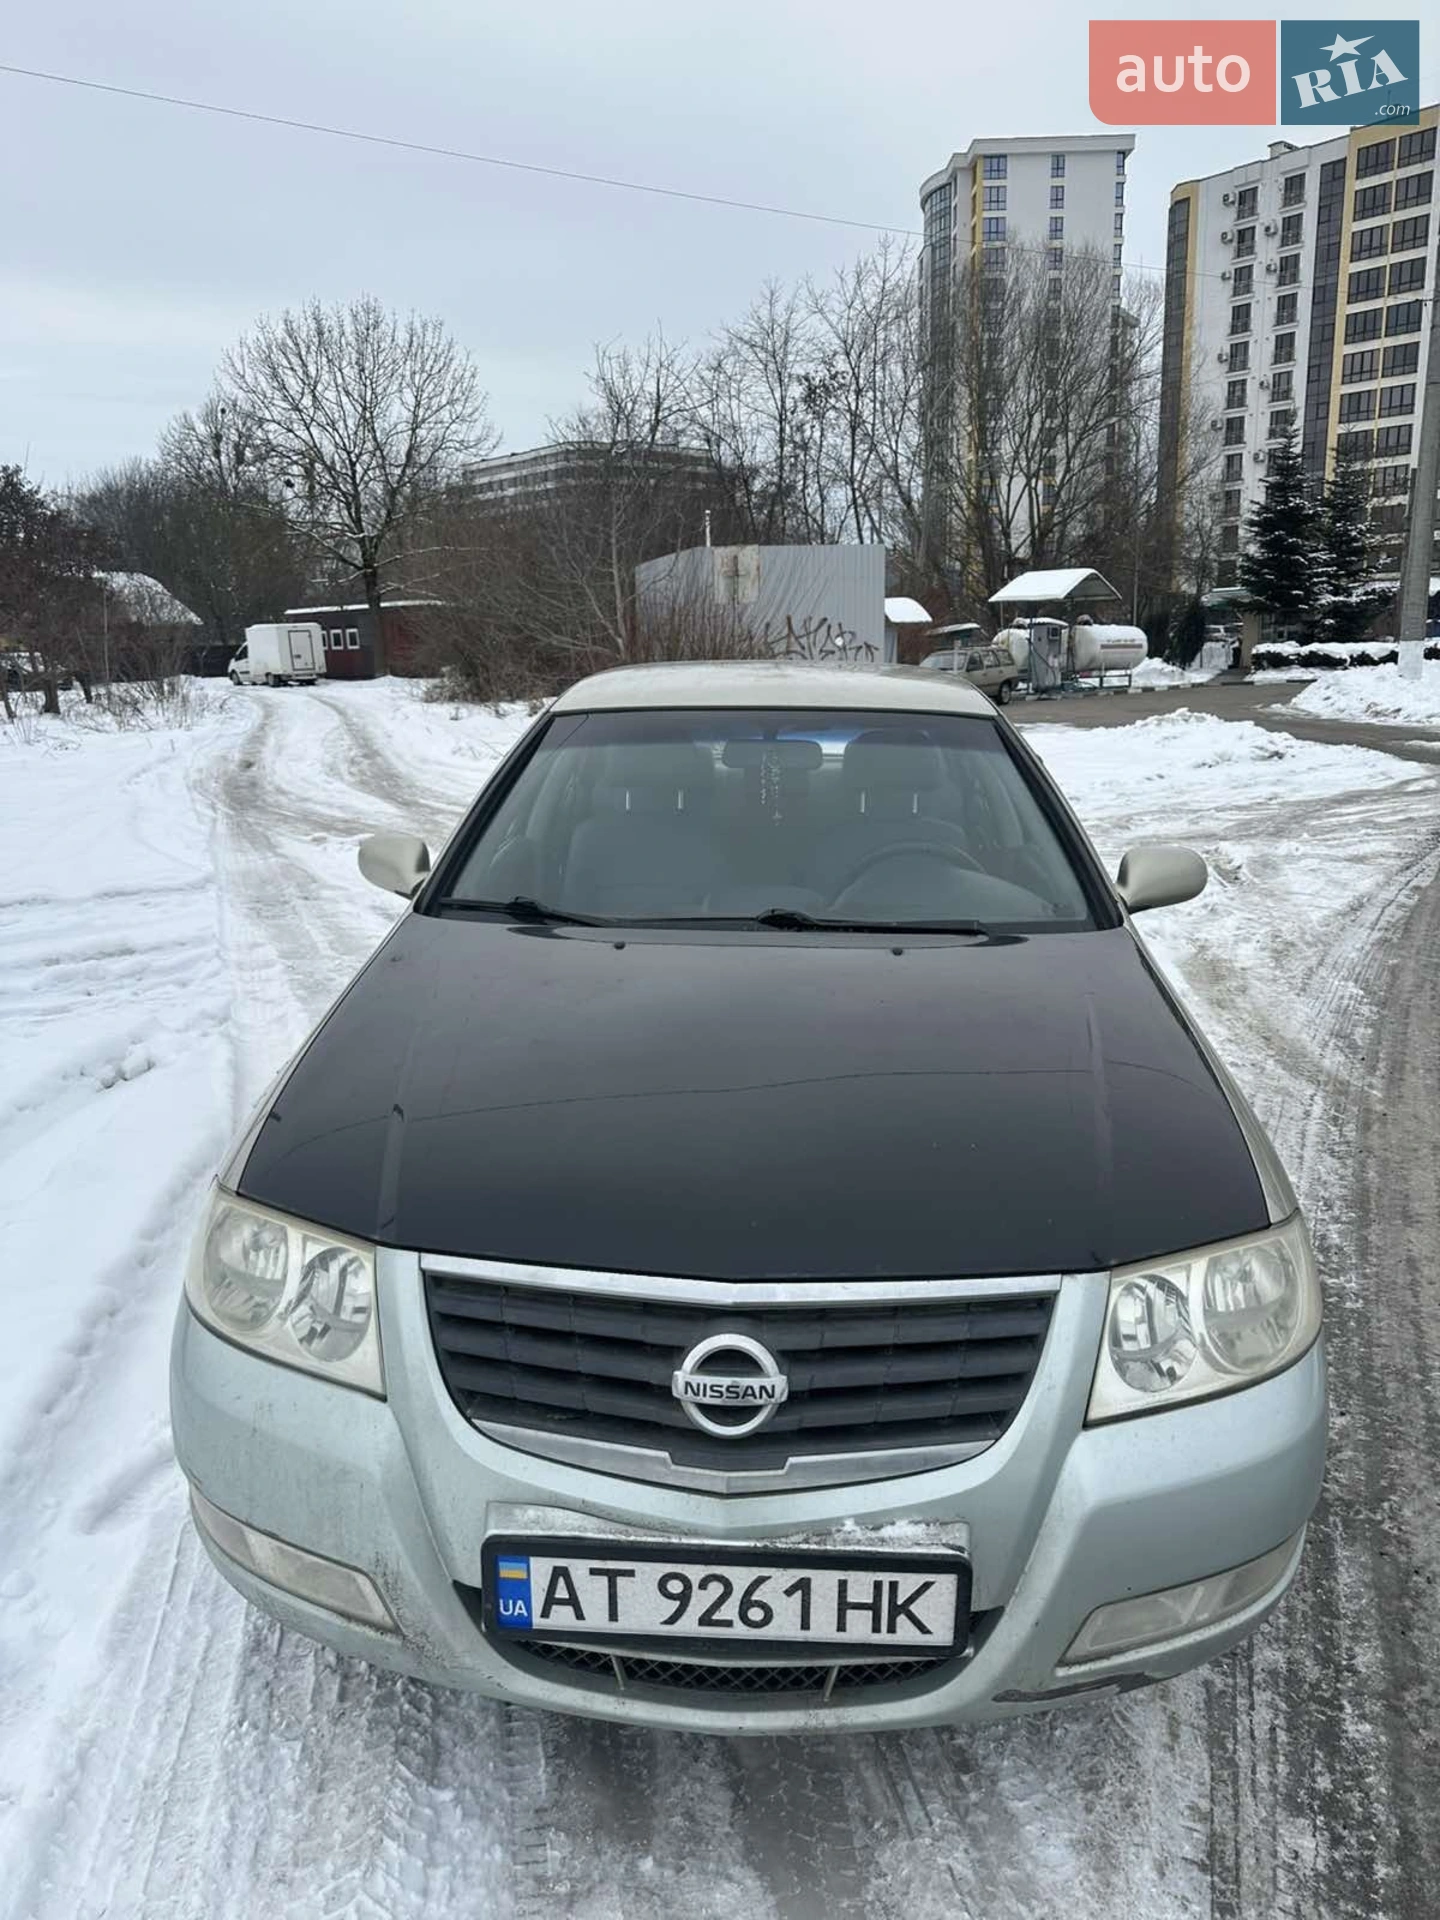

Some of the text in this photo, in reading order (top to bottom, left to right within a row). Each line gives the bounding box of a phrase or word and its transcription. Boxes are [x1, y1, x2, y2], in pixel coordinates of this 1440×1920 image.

[684, 1381, 775, 1400] NISSAN
[500, 1600, 528, 1617] UA
[539, 1565, 936, 1635] AT 9261 HK
